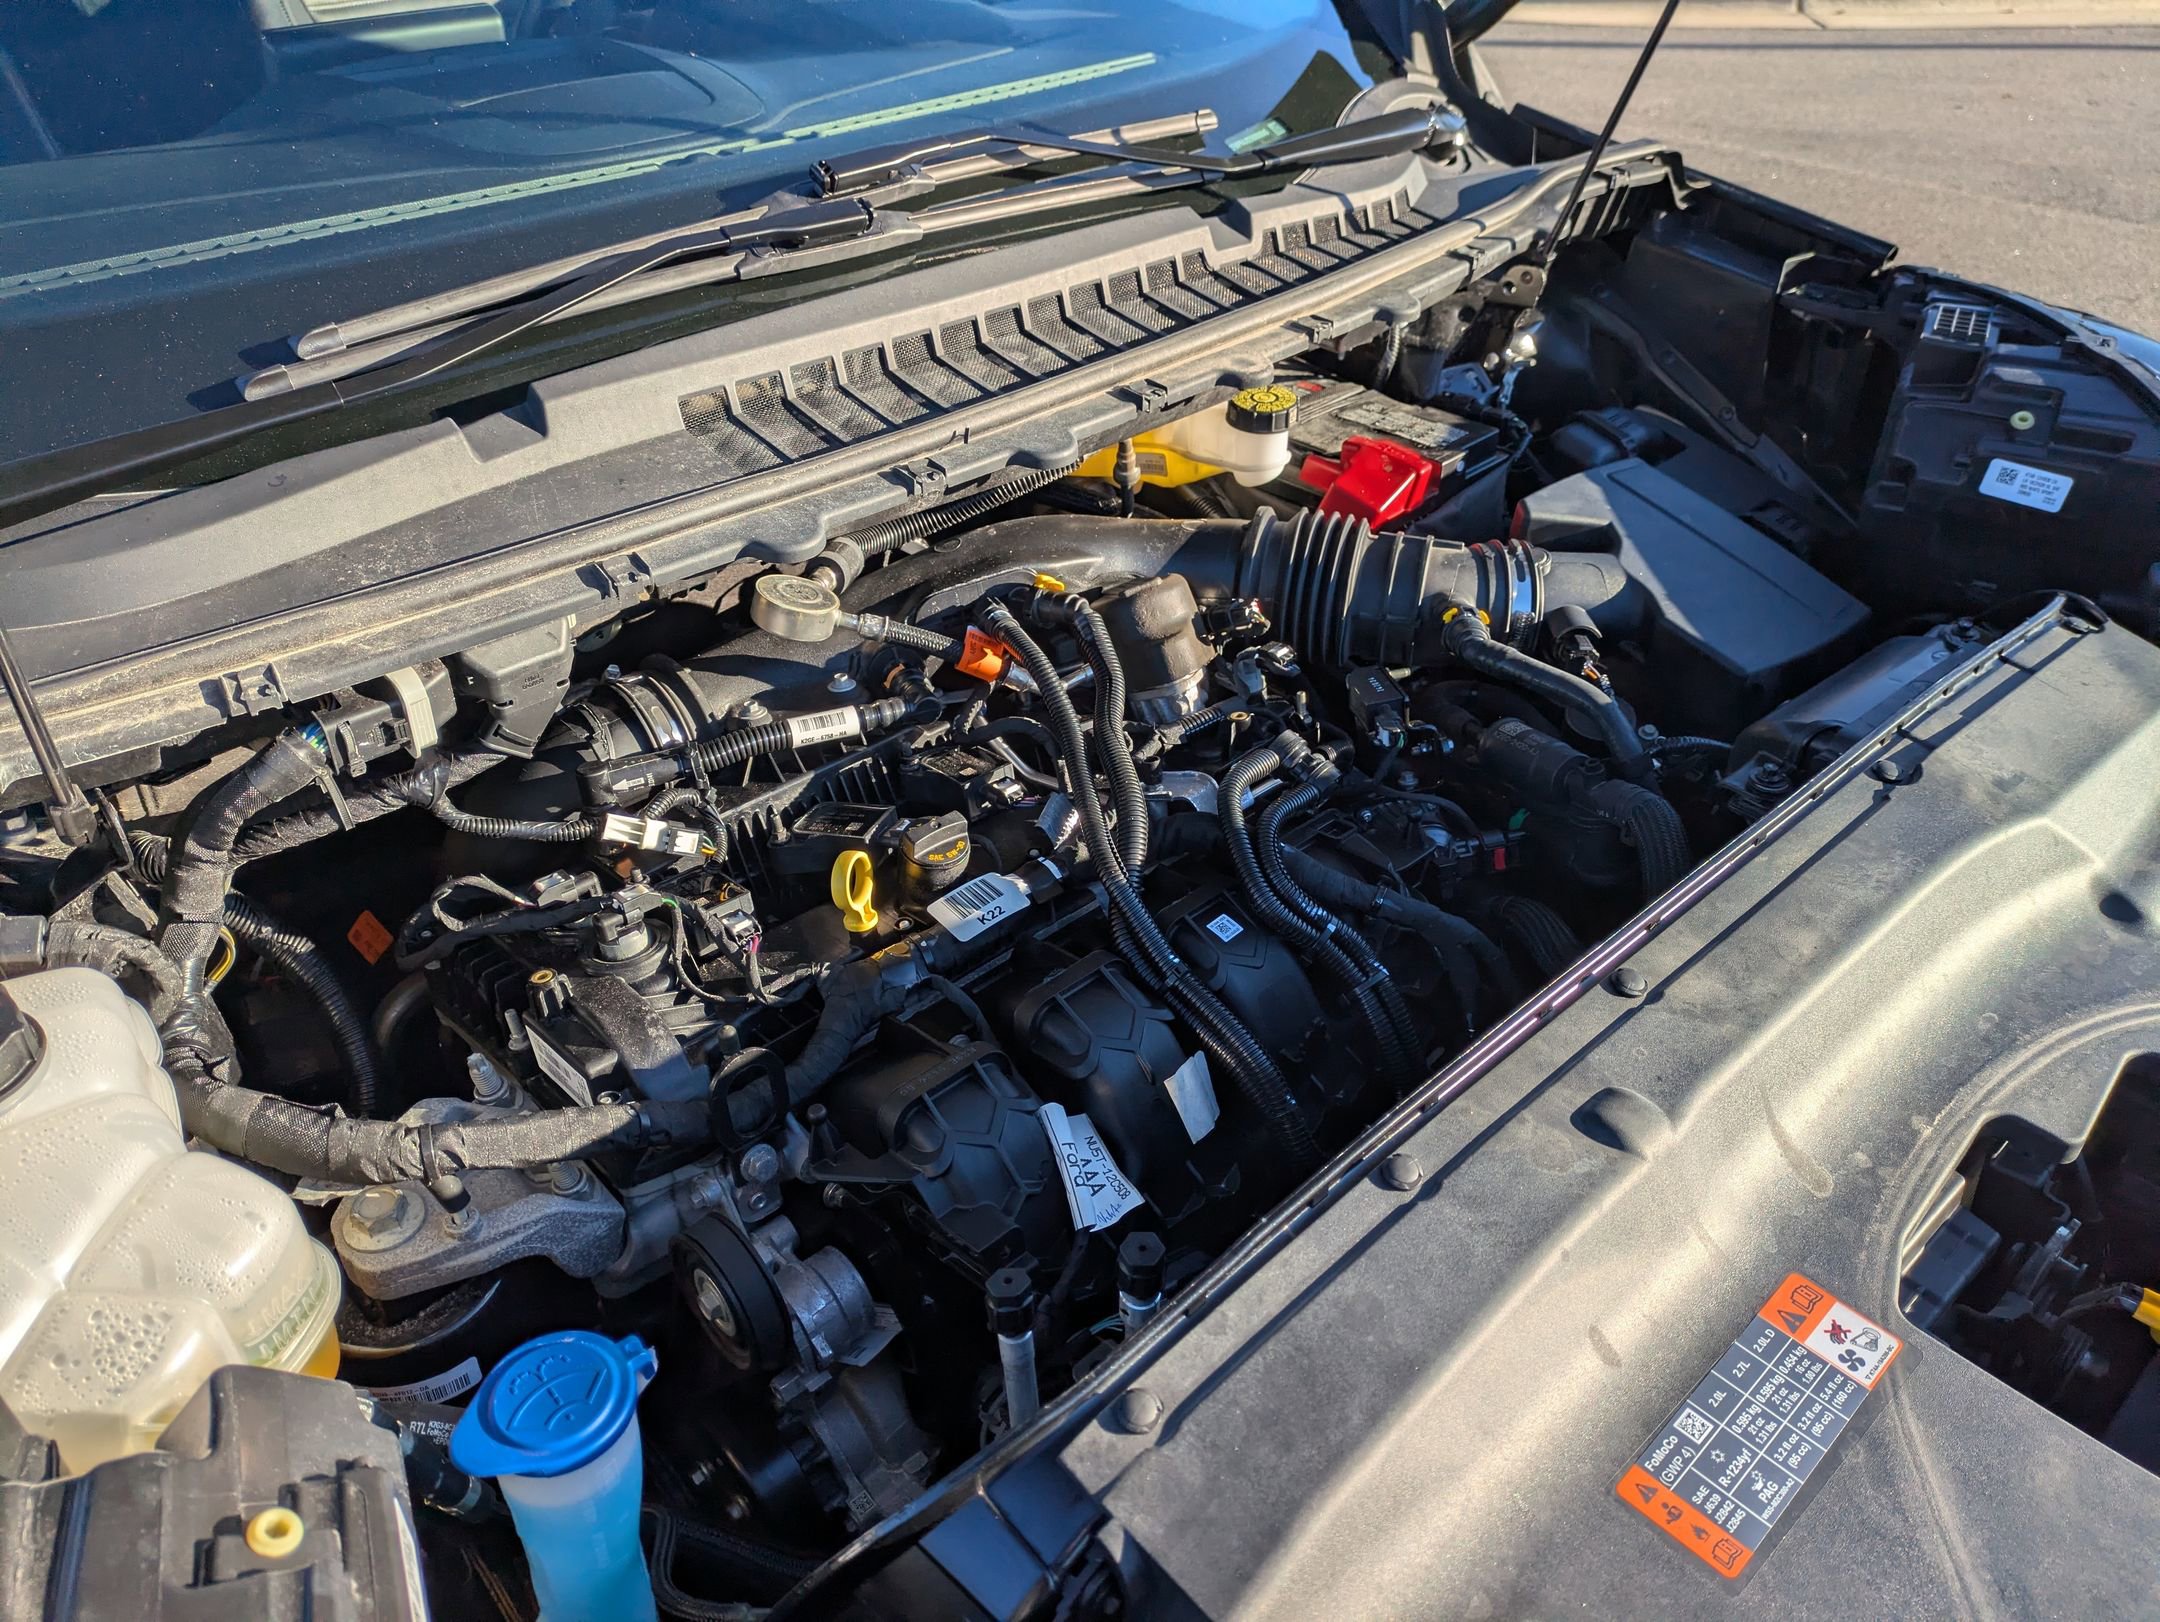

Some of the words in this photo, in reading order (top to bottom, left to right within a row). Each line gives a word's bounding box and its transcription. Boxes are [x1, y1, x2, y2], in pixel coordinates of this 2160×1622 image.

[977, 906, 1006, 925] K22
[1062, 1142, 1090, 1187] Ford
[1752, 1334, 1771, 1352] 2.0L
[1764, 1328, 1775, 1338] D
[1732, 1360, 1750, 1378] 2.7L
[1778, 1352, 1799, 1374] 0.454
[1792, 1344, 1808, 1358] kg
[1794, 1364, 1805, 1374] 16
[1801, 1358, 1811, 1368] oz
[1810, 1361, 1823, 1374] lbs
[1708, 1389, 1726, 1408] 2.0L
[1755, 1381, 1776, 1403] 0.595
[1769, 1373, 1786, 1386] kg
[1770, 1393, 1782, 1405] 21
[1778, 1386, 1788, 1397] oz
[1819, 1387, 1833, 1401] 5.4
[1827, 1381, 1838, 1390] fl
[1833, 1373, 1844, 1384] oz
[1830, 1390, 1849, 1410] (160
[1843, 1380, 1858, 1394] cc)
[1778, 1399, 1793, 1414] 1.31
[1787, 1390, 1801, 1402] lbs
[1730, 1411, 1752, 1434] 0.595
[1745, 1402, 1762, 1416] kg
[1747, 1423, 1759, 1436] 21
[1755, 1416, 1766, 1427] oz
[1796, 1416, 1812, 1431] 3.2
[1805, 1410, 1816, 1420] fl
[1811, 1402, 1822, 1414] oz
[1810, 1421, 1826, 1438] (95
[1819, 1410, 1836, 1426] cc)
[1754, 1429, 1770, 1445] 1.31
[1764, 1420, 1778, 1432] lbs
[1644, 1434, 1680, 1472] FoMoCo
[1773, 1447, 1788, 1462] 3.2
[1782, 1440, 1792, 1450] fl
[1788, 1432, 1800, 1445] oz
[1786, 1452, 1802, 1469] (95
[1796, 1440, 1812, 1457] cc)
[1658, 1454, 1686, 1487] (GWP
[1680, 1444, 1696, 1460] 4)
[1718, 1447, 1754, 1488] R-1234yf
[1691, 1484, 1710, 1505] SAE
[1702, 1492, 1722, 1514] J639
[1757, 1480, 1780, 1504] PAG
[1713, 1499, 1736, 1524] J2842
[1725, 1508, 1747, 1534] J2845
